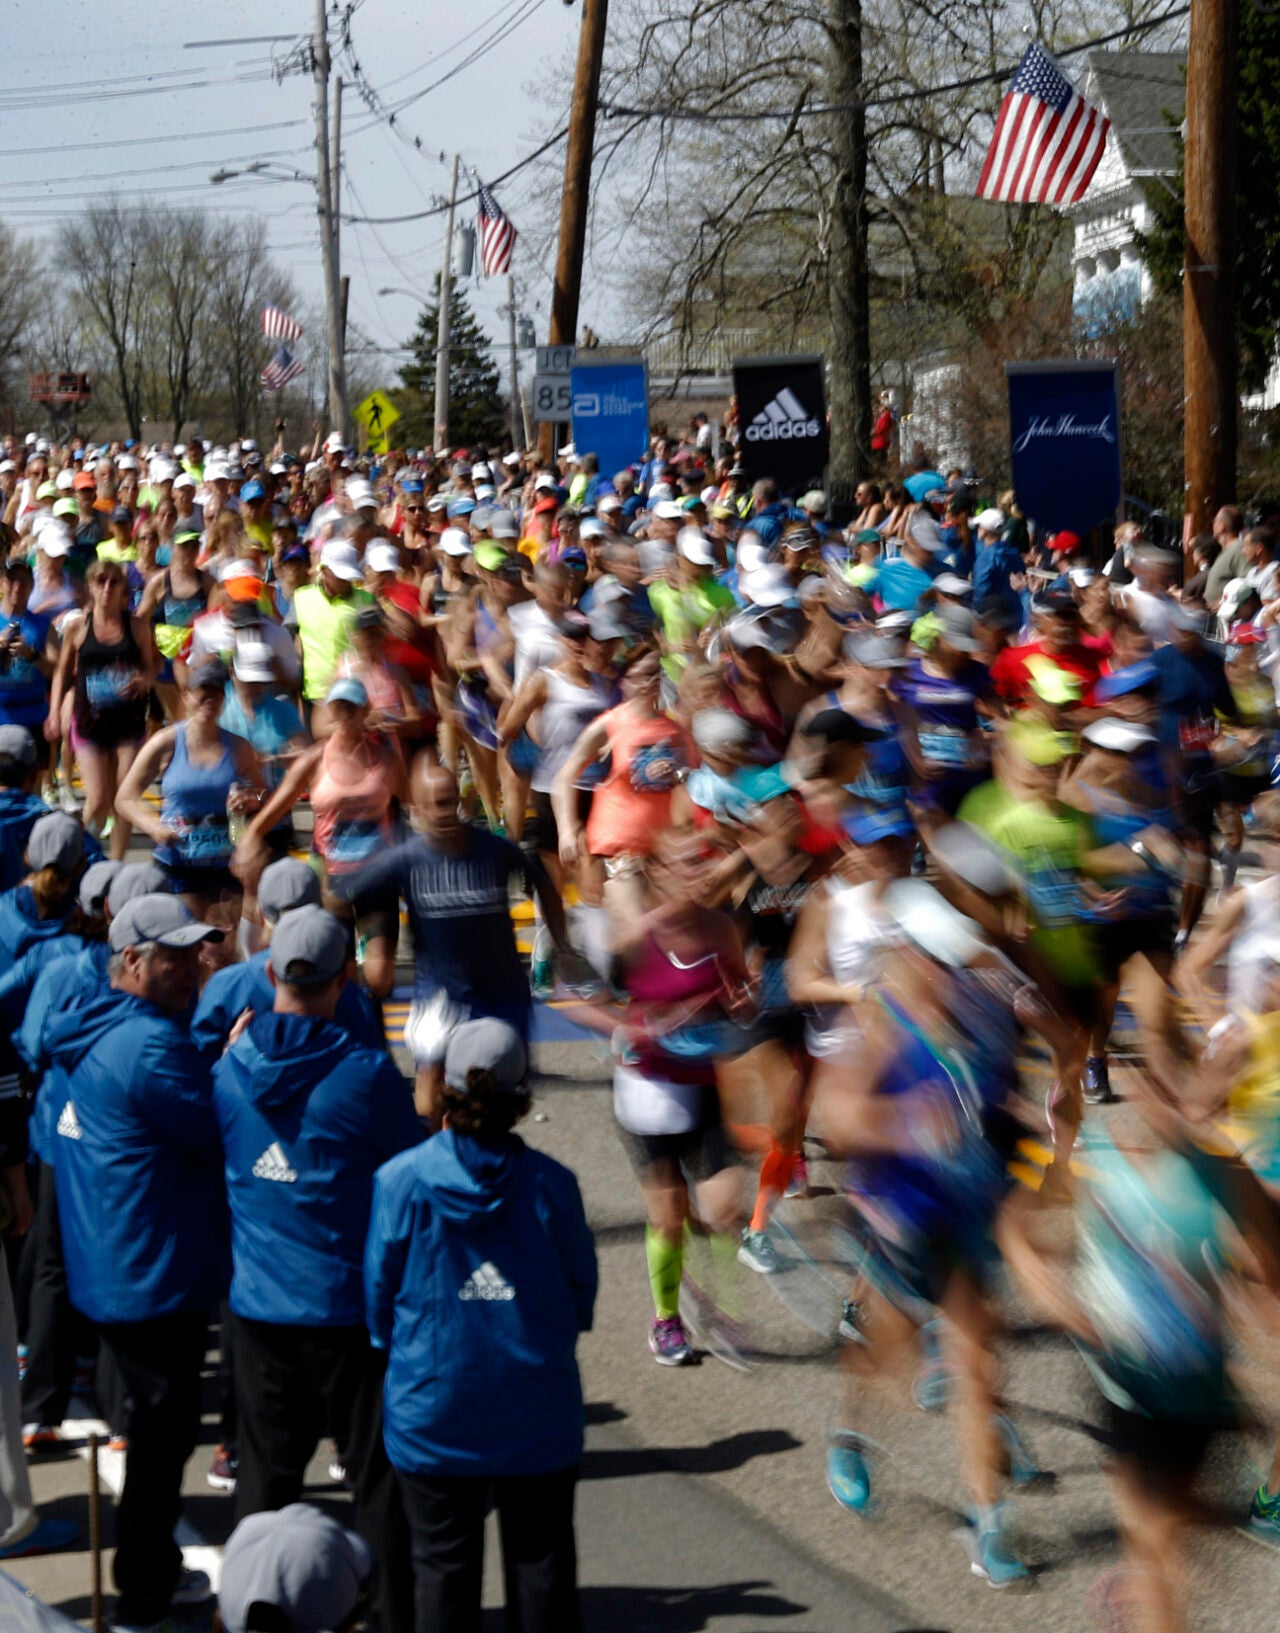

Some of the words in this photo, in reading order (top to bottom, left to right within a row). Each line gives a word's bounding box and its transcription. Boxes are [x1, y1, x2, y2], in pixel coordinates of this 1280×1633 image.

[545, 350, 572, 369] JCT
[538, 386, 571, 411] 85
[745, 415, 820, 442] adidas
[1013, 414, 1054, 454] John
[1054, 413, 1115, 444] Hancock
